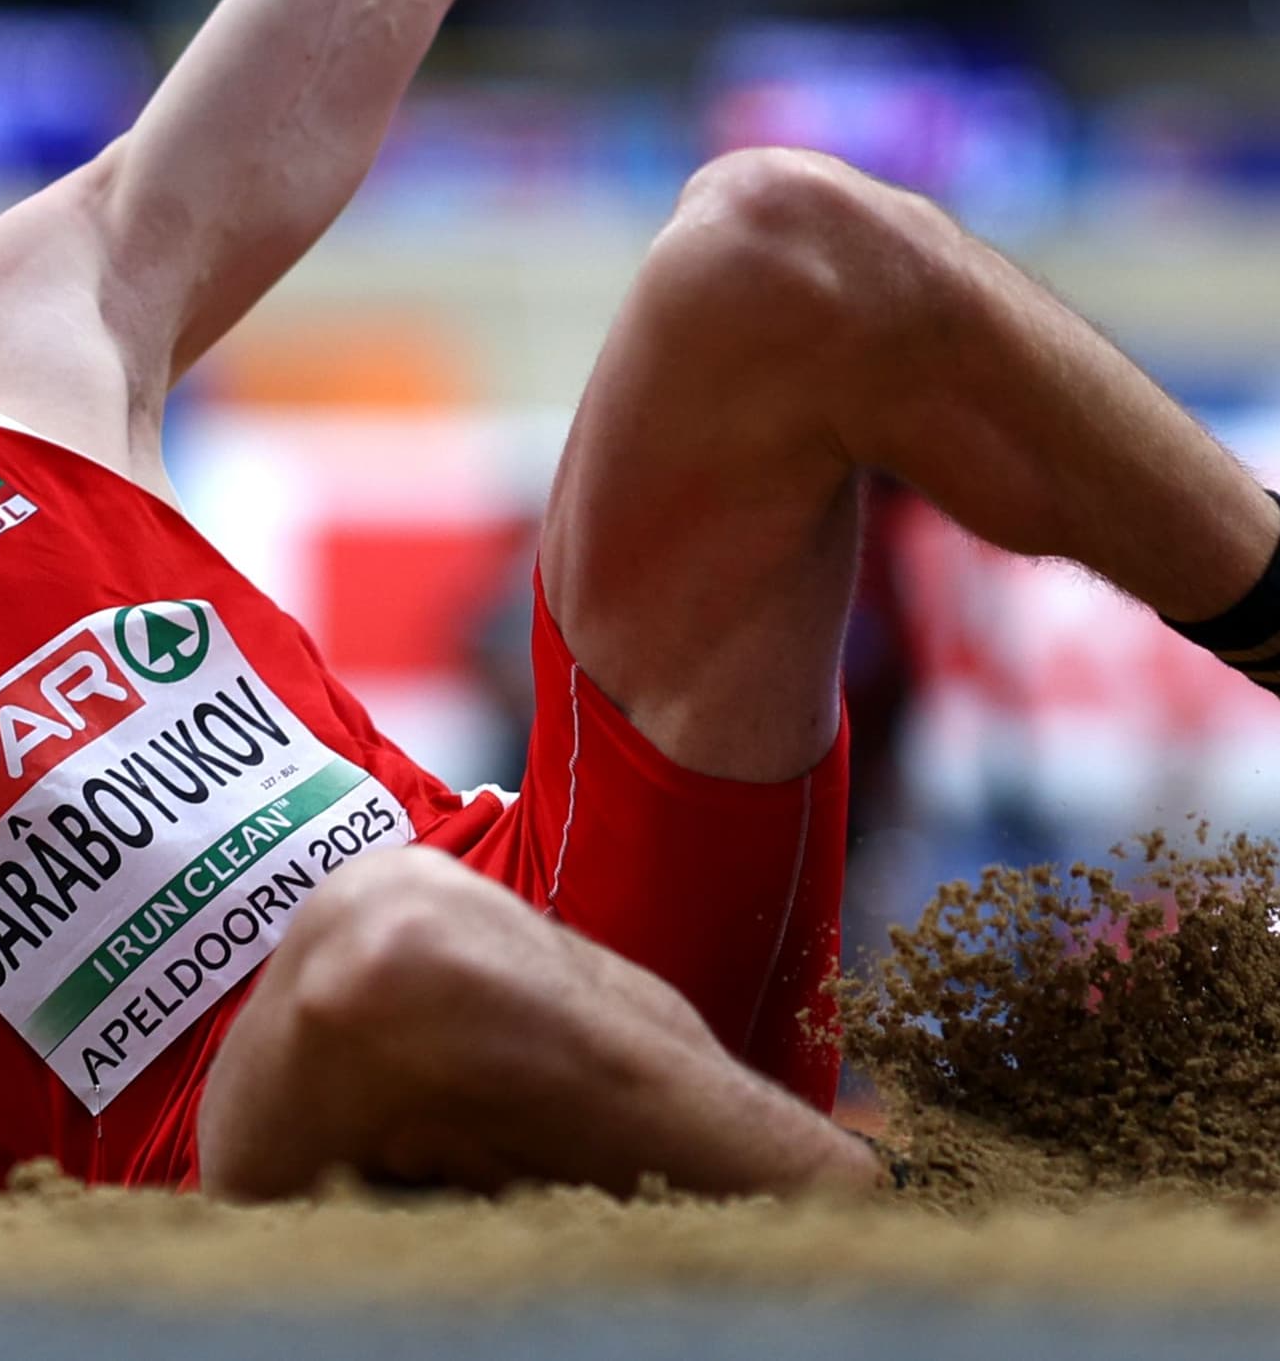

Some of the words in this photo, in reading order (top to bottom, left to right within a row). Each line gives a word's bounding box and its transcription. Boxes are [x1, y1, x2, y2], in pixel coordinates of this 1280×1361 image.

[81, 860, 316, 1086] APELDOORN
[308, 797, 396, 875] 2025
[92, 958, 115, 984] I
[106, 890, 190, 970] RUN
